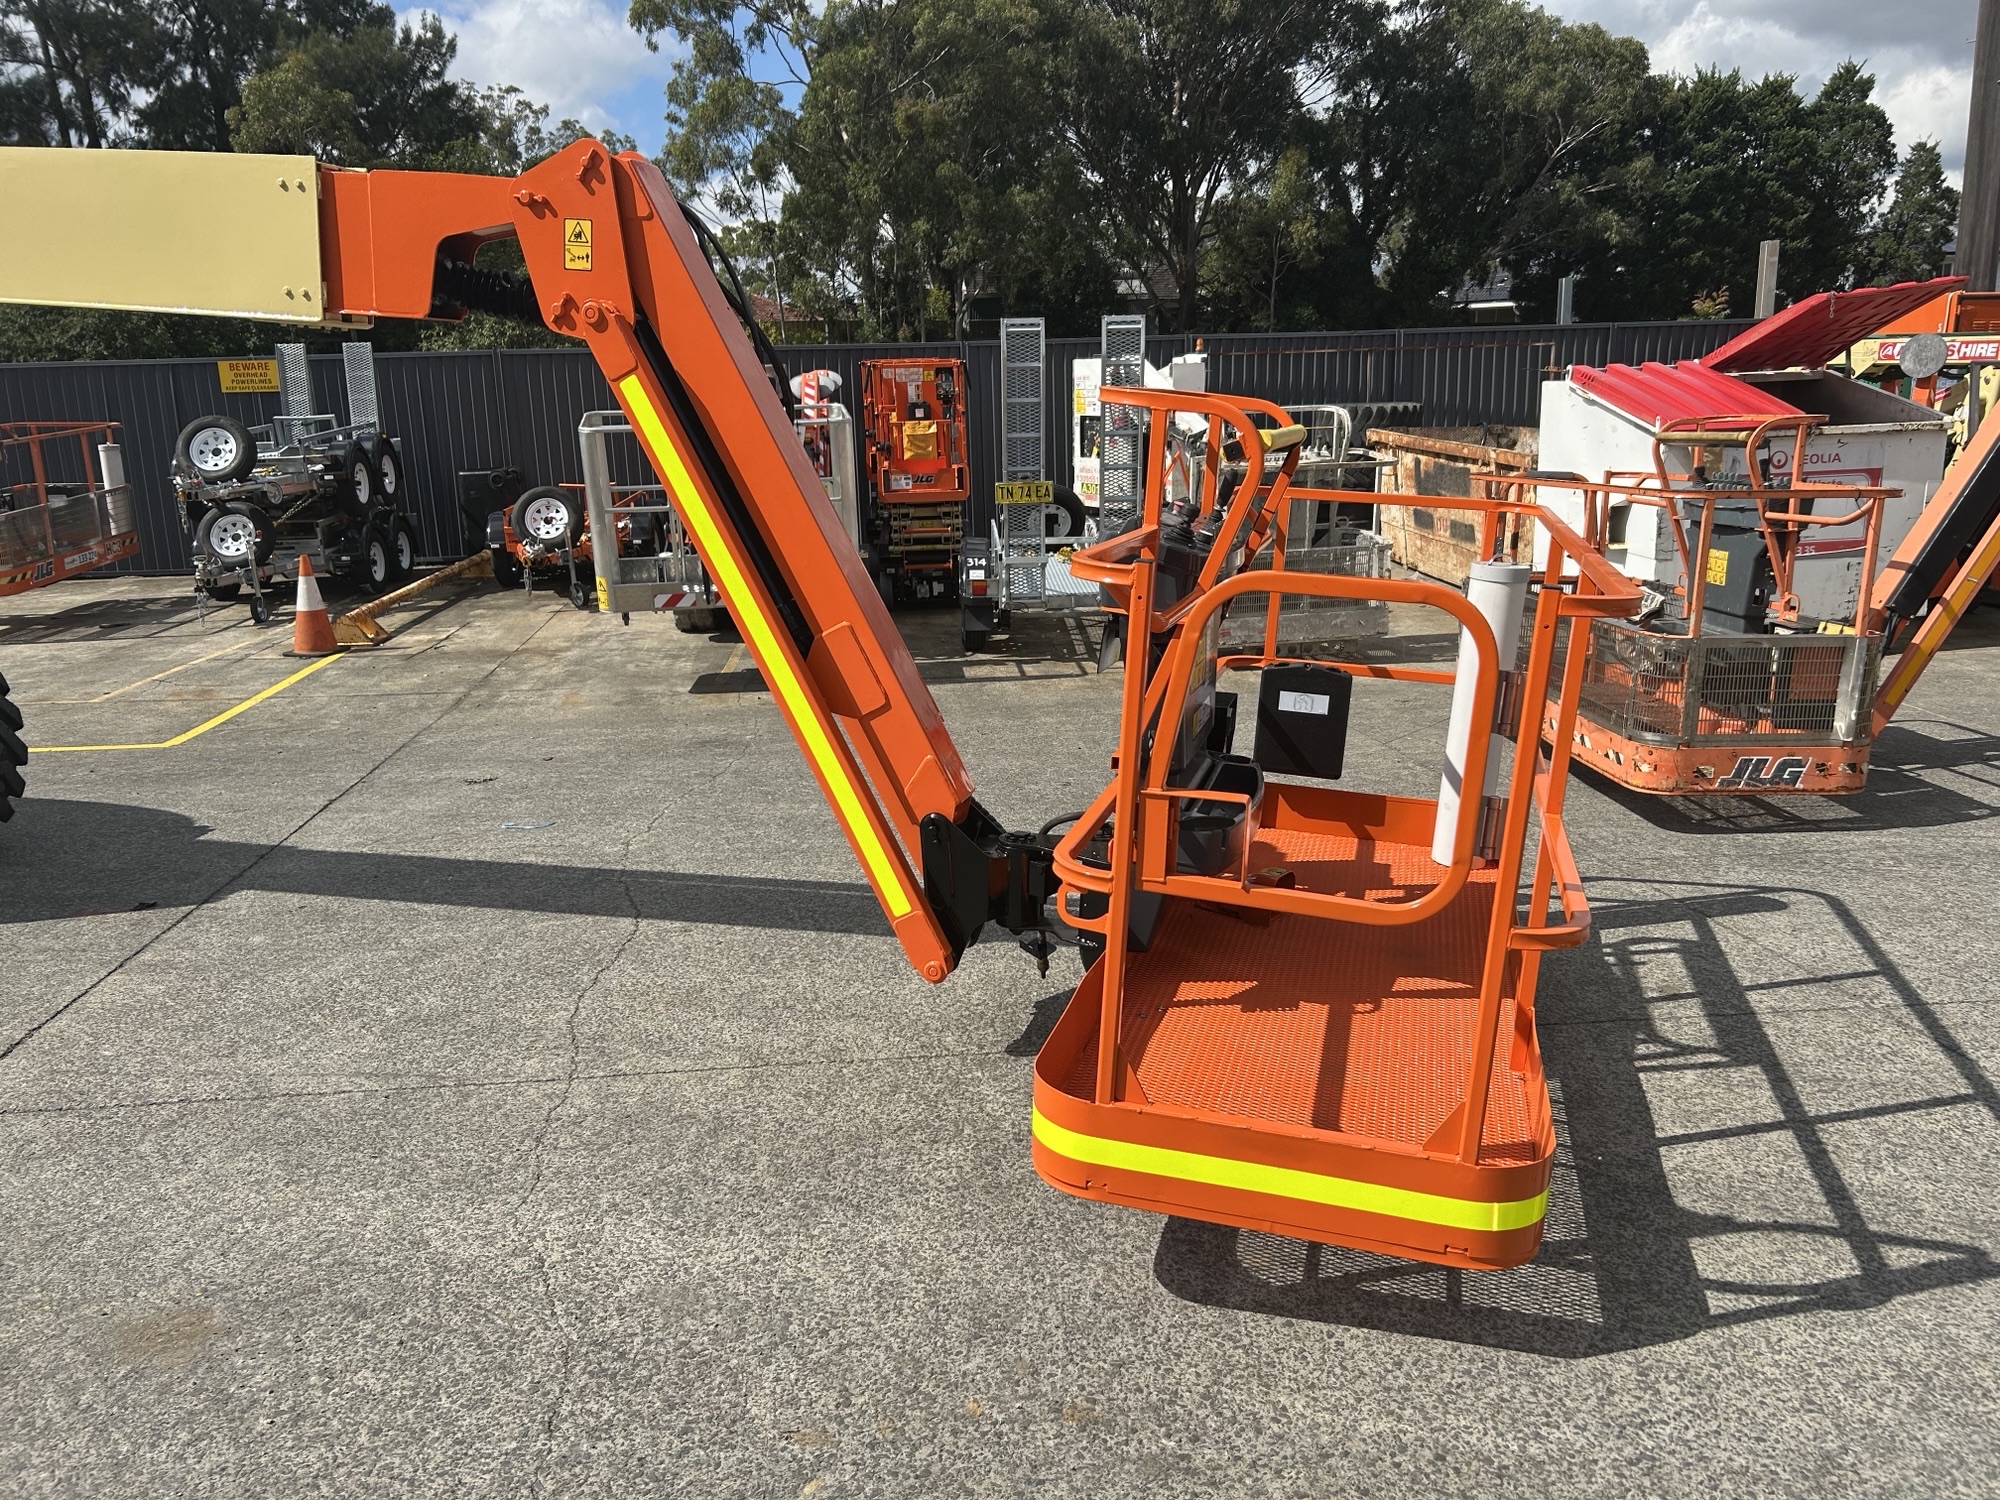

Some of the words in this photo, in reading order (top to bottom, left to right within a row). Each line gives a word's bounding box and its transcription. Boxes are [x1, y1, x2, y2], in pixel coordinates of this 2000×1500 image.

[1960, 342, 1999, 357] HIRE
[229, 362, 270, 371] BEWARE
[1792, 453, 1842, 465] EOLIA
[912, 474, 935, 484] JLG
[104, 539, 122, 557] HC3
[966, 557, 987, 567] 314
[34, 559, 55, 581] JLG
[1714, 756, 1812, 788] JLG
